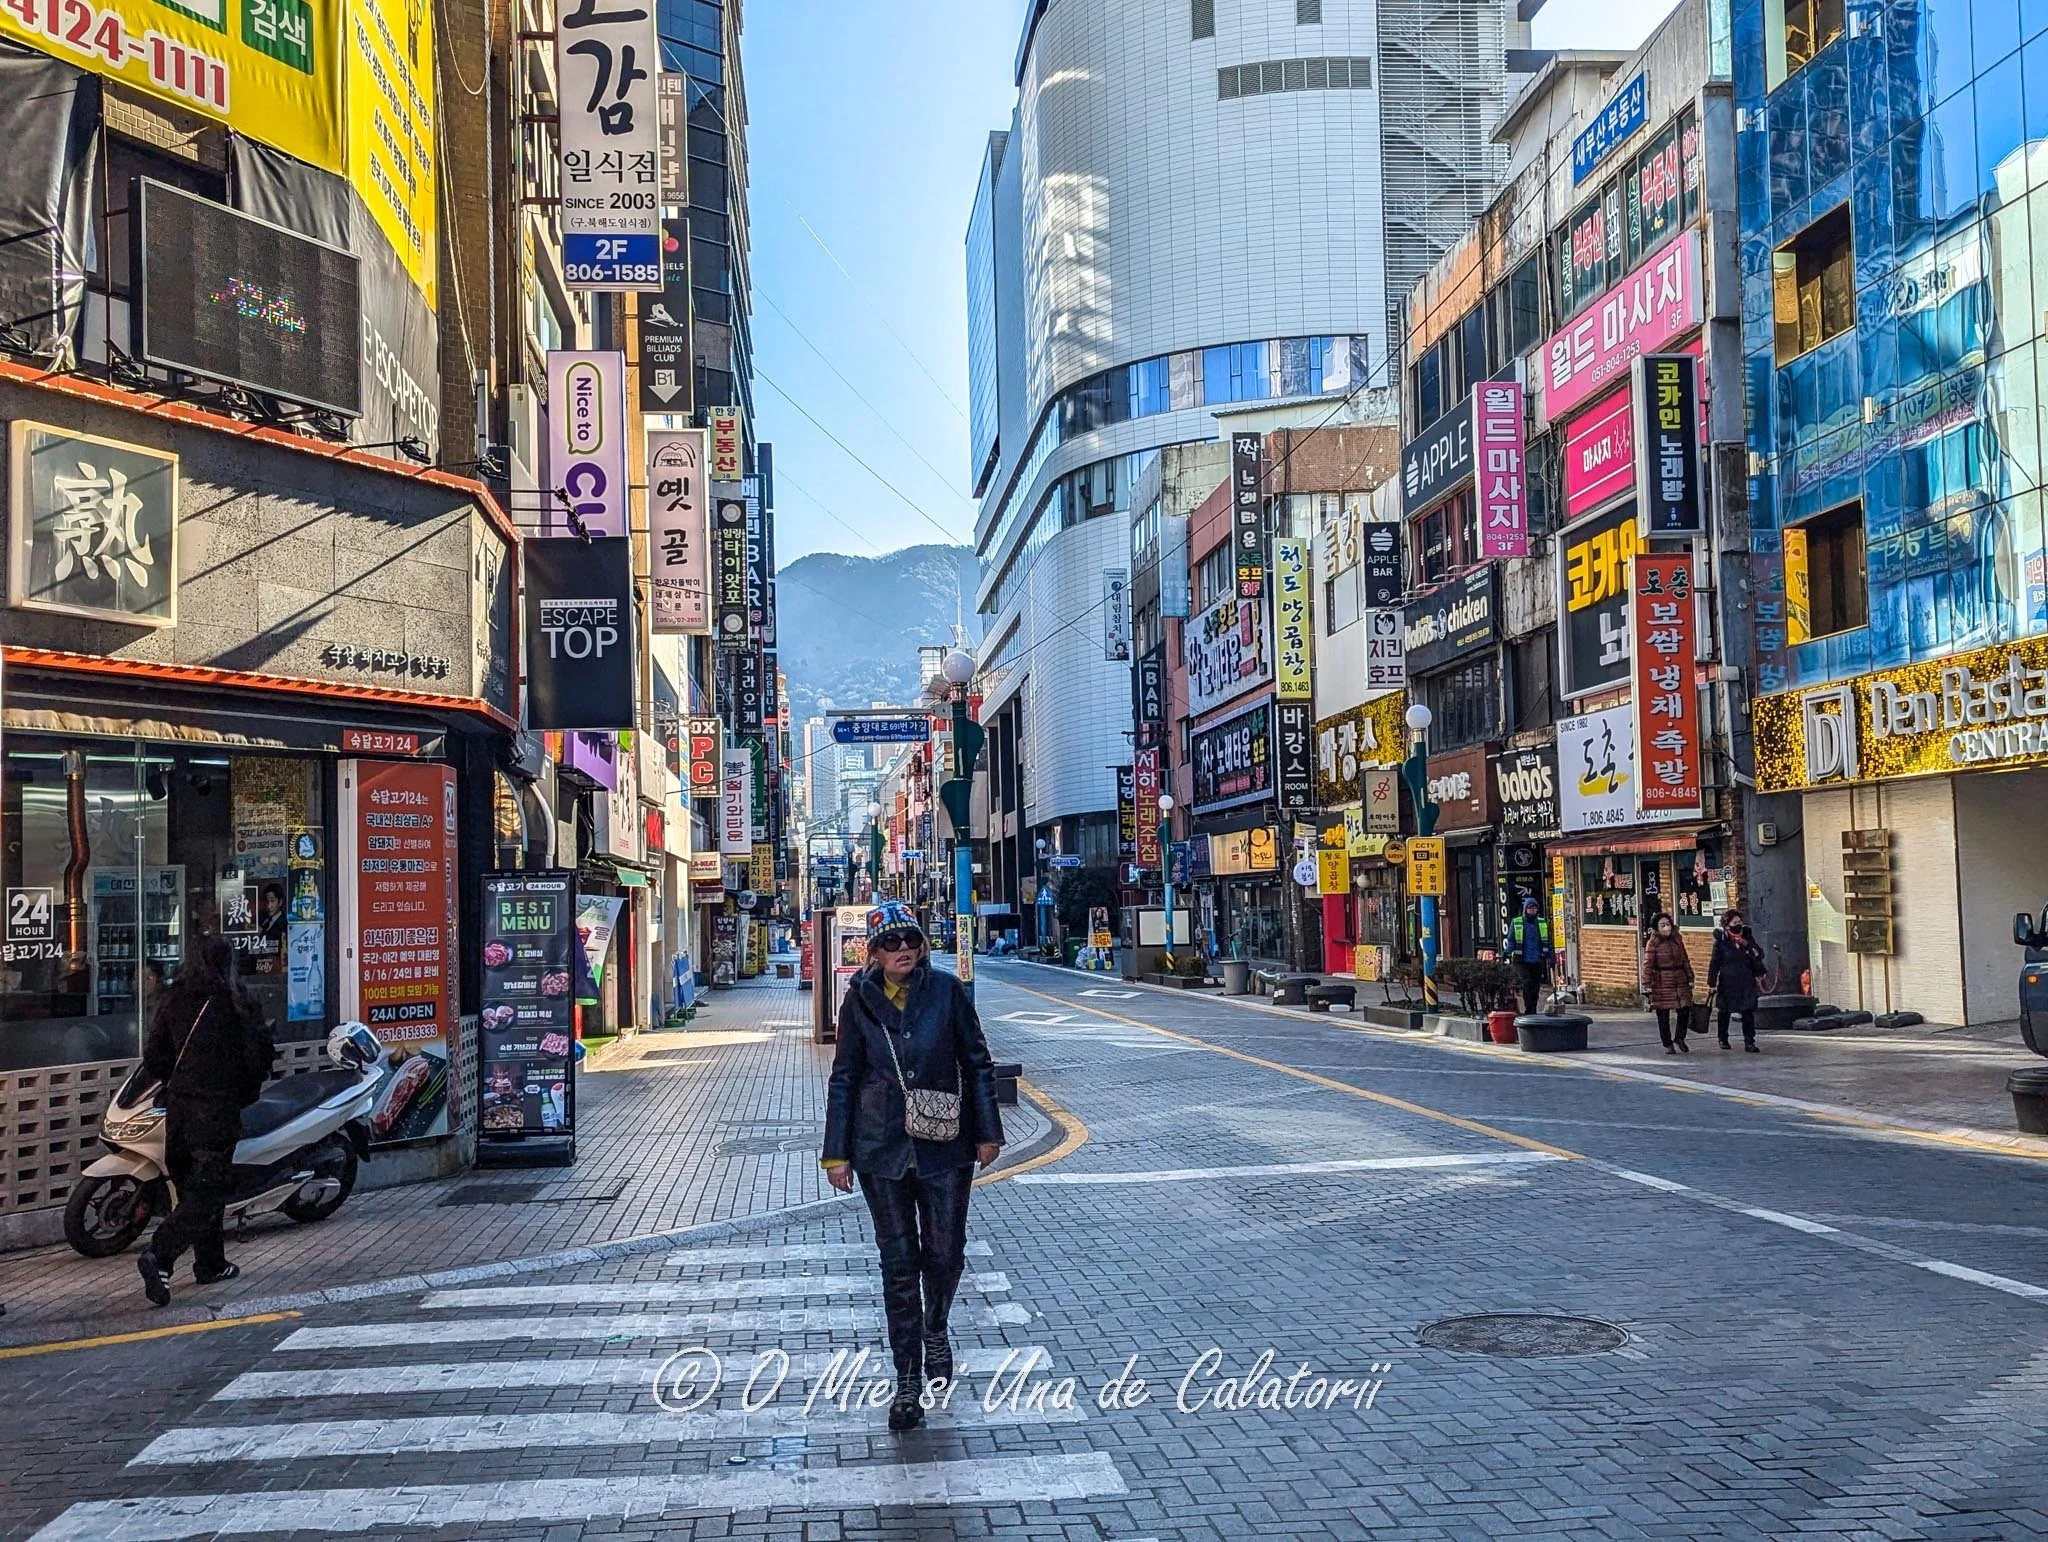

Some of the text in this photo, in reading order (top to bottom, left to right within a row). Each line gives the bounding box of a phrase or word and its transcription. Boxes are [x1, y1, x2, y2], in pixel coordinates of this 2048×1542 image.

[250, 0, 308, 55] 검색
[1575, 82, 1642, 167] 새부산 부동산
[564, 149, 656, 184] 일식점
[1642, 139, 1678, 219] 부동산
[565, 192, 656, 210] SINCE 2003
[595, 239, 627, 260] 2F
[1573, 208, 1604, 280] 부동산
[565, 263, 659, 282] 806-1585
[1552, 246, 1684, 391] 월드 마사지
[1670, 308, 1682, 331] 3F
[645, 335, 682, 344] PREMIUM
[646, 344, 681, 354] BILLIADS
[653, 353, 675, 363] CLUB
[1591, 337, 1641, 382] 051-804-1253
[657, 372, 673, 387] B1
[576, 377, 592, 441] Nice to
[1657, 362, 1686, 502] 코카인 노래방
[715, 419, 737, 473] 부동산
[1421, 419, 1469, 490] APPLE
[1583, 435, 1611, 473] 마사지
[742, 477, 760, 539] 베를린
[1240, 470, 1258, 548] 노래타운
[54, 462, 154, 589] 熟
[1498, 542, 1513, 551] 3F
[1239, 554, 1261, 566] 소주
[1367, 555, 1399, 565] APPLE
[1238, 567, 1263, 580] 호프
[1373, 568, 1393, 577] BAR
[1241, 581, 1261, 596] 3F
[541, 608, 618, 625] ESCAPE
[1447, 595, 1488, 633] chicken
[541, 626, 618, 658] TOP
[1370, 639, 1402, 658] 치킨
[361, 649, 411, 673] 돼지고기
[418, 655, 451, 676] 전문점
[1370, 665, 1403, 684] 호프
[742, 656, 757, 725] 가라오케
[1146, 672, 1159, 716] BAR
[1280, 682, 1310, 693] 806.1463
[1871, 681, 1938, 739] Den
[1559, 721, 1576, 734] SINCE
[1283, 708, 1306, 778] 바캉스
[691, 736, 714, 784] PC
[1284, 783, 1309, 791] ROOM
[1646, 787, 1697, 798] 806-4845
[371, 789, 429, 805] 숙달고기24는
[366, 813, 420, 828] 국내산 최상급
[362, 859, 388, 873] 최저의
[11, 894, 49, 925] 24
[373, 902, 394, 912] 드리고
[502, 902, 551, 914] BEST
[16, 927, 45, 935] HOUR
[502, 916, 551, 930] MENU
[364, 928, 404, 947] 회식하기
[0, 943, 64, 961] 달고기24
[364, 988, 388, 1000] 100인
[371, 1004, 433, 1021] 24시 OPEN
